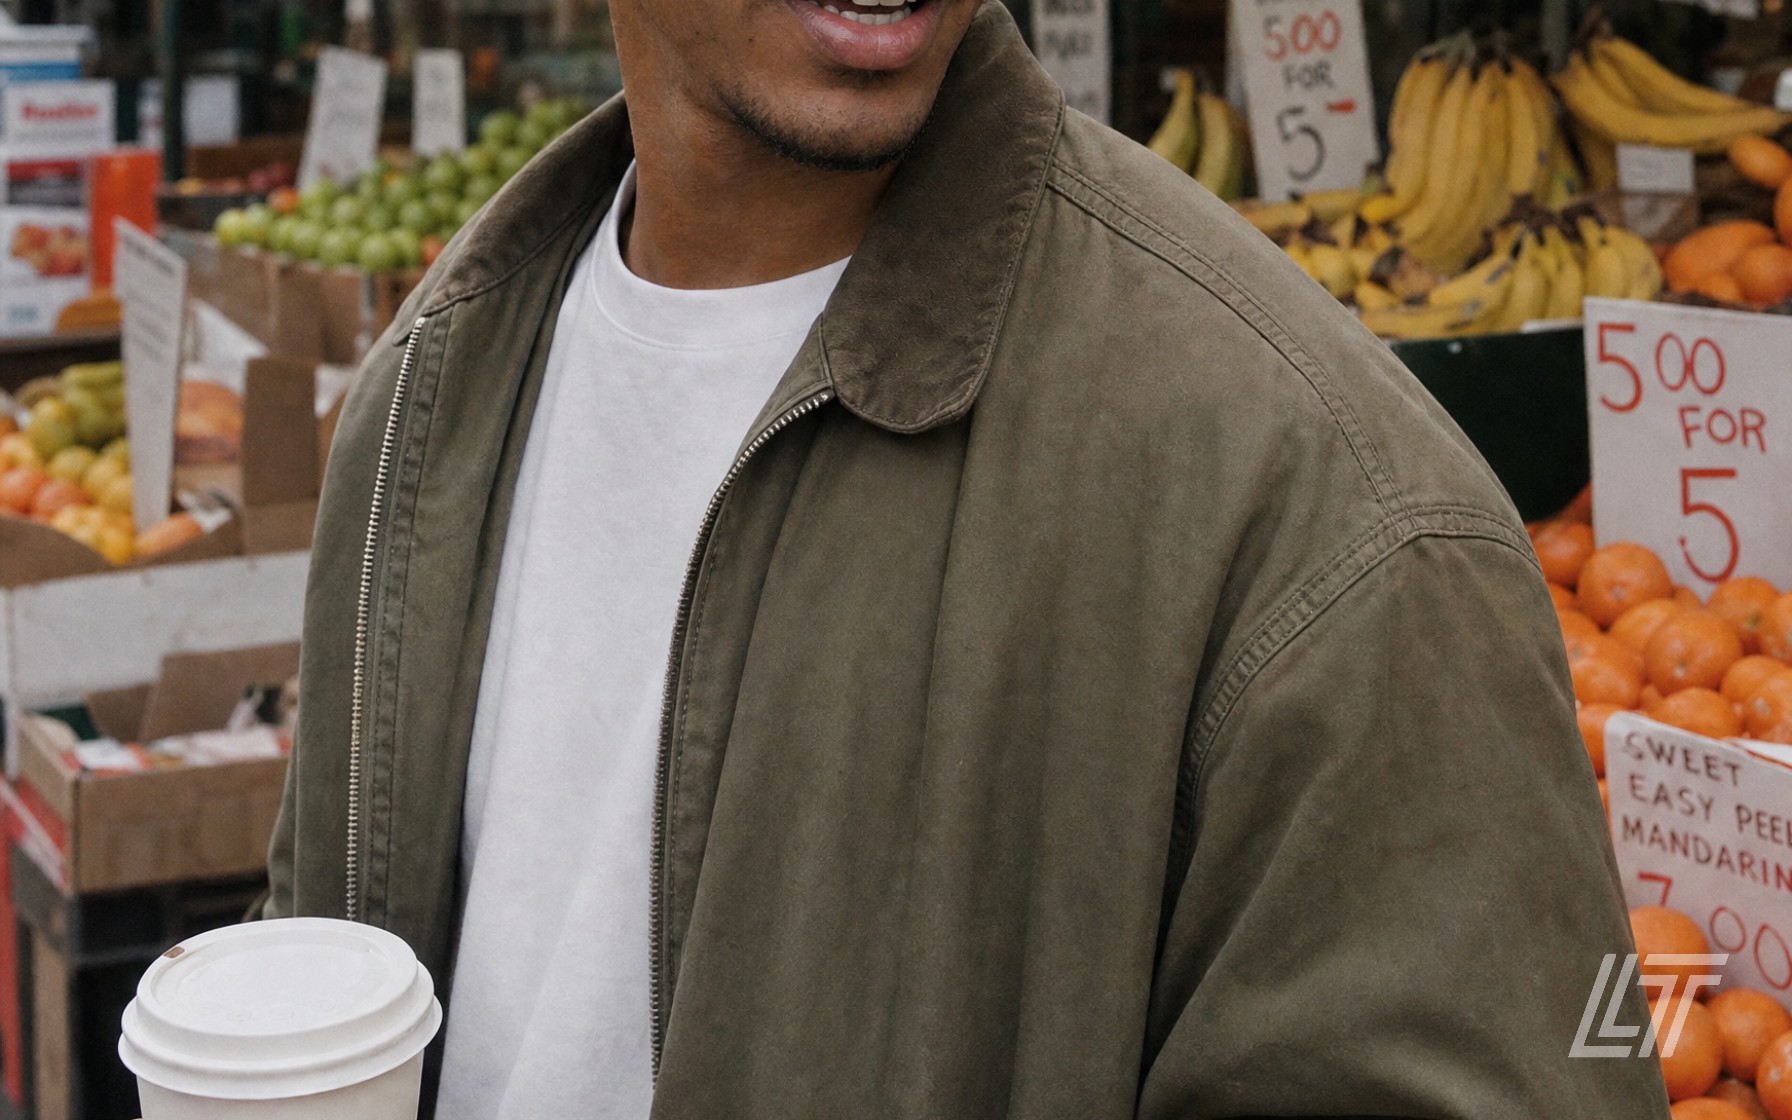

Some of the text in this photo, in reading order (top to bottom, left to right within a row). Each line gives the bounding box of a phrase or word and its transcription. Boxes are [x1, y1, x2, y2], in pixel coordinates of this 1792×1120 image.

[1282, 61, 1334, 89] FOR
[1276, 106, 1325, 181] 5
[1679, 405, 1766, 454] FOR
[1679, 468, 1740, 584] 5
[1624, 731, 1742, 787] SWEET
[1628, 772, 1716, 824] EASY
[1621, 814, 1792, 893] MANDARIN
